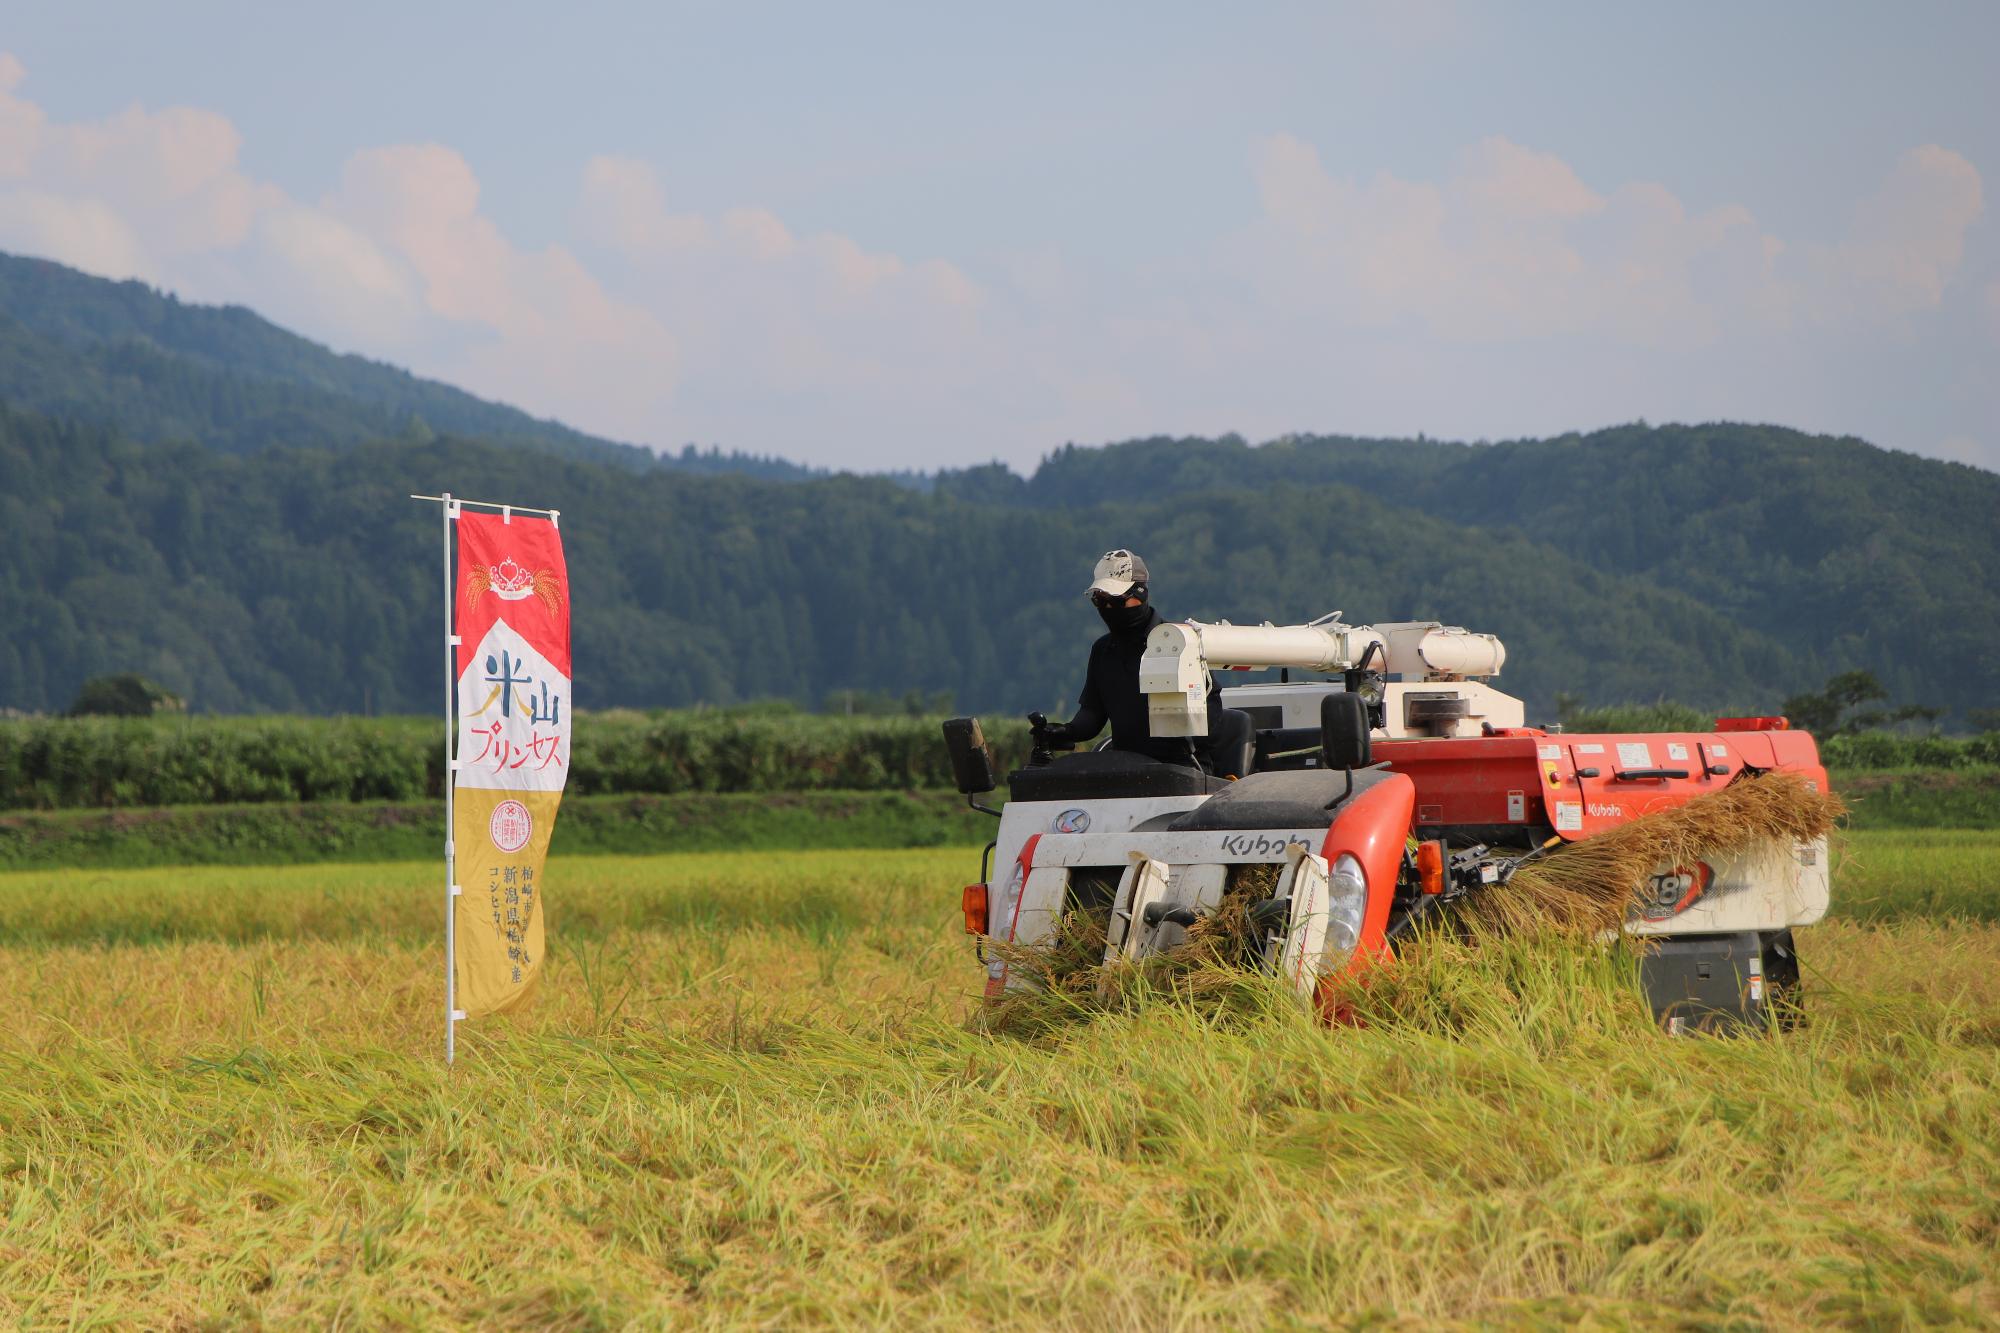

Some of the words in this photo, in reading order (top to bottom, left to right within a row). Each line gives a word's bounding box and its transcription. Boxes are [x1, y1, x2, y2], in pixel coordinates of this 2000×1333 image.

[465, 649, 559, 726] 米山
[470, 720, 562, 775] プリンセス
[1588, 803, 1621, 816] Kubota
[503, 866, 521, 983] 新潟県柏崎産
